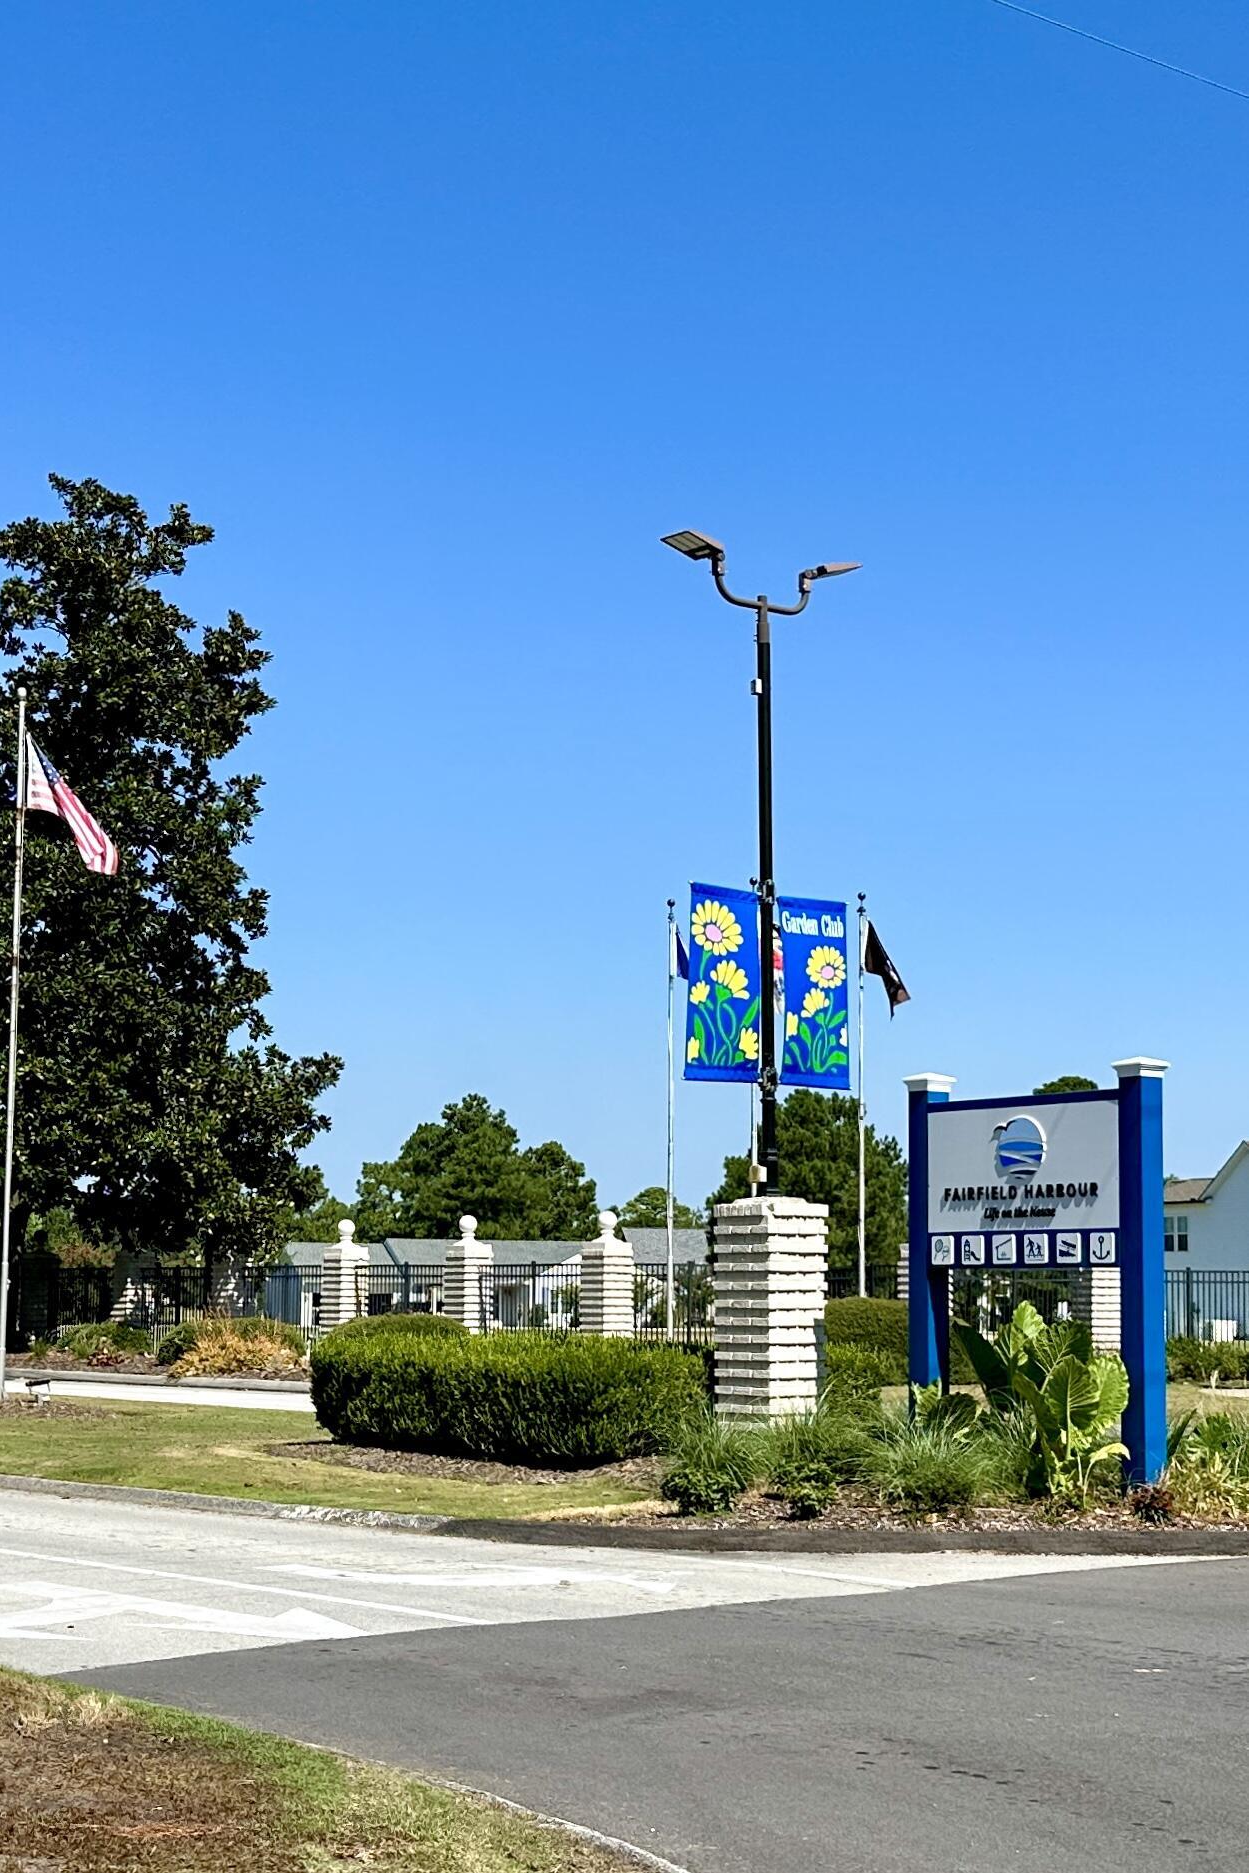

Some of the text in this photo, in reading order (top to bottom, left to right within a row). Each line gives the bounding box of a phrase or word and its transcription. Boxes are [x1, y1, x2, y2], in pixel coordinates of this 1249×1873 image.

[782, 911, 844, 938] Garden Club
[944, 1182, 1098, 1201] FAIRFIELD HARBOUR
[984, 1207, 999, 1221] Life
[1001, 1209, 1012, 1218] on
[1014, 1206, 1028, 1218] the
